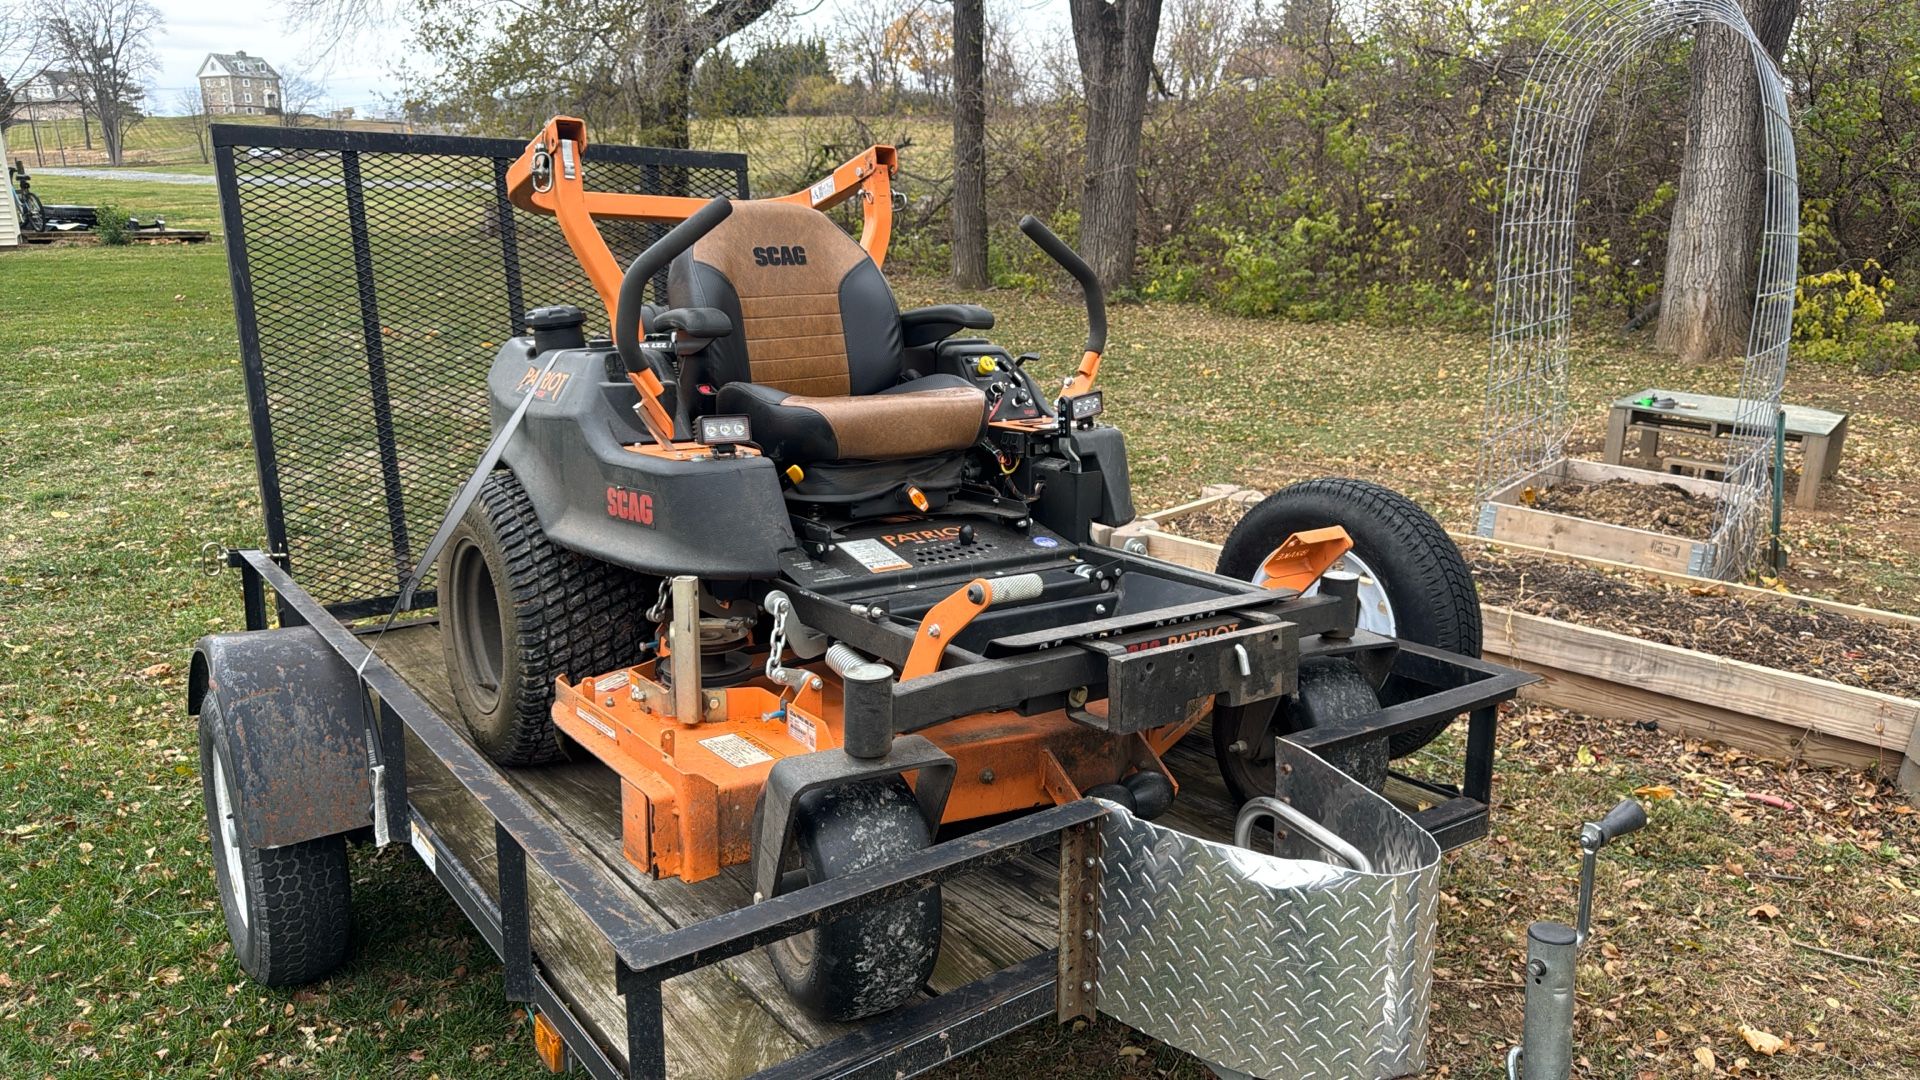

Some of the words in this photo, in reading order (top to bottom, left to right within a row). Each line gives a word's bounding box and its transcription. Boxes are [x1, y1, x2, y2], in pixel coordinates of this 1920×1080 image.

[752, 245, 807, 267] SCAG
[515, 366, 571, 401] PARIOT
[606, 486, 653, 525] SCAG
[881, 525, 977, 548] PATRIO
